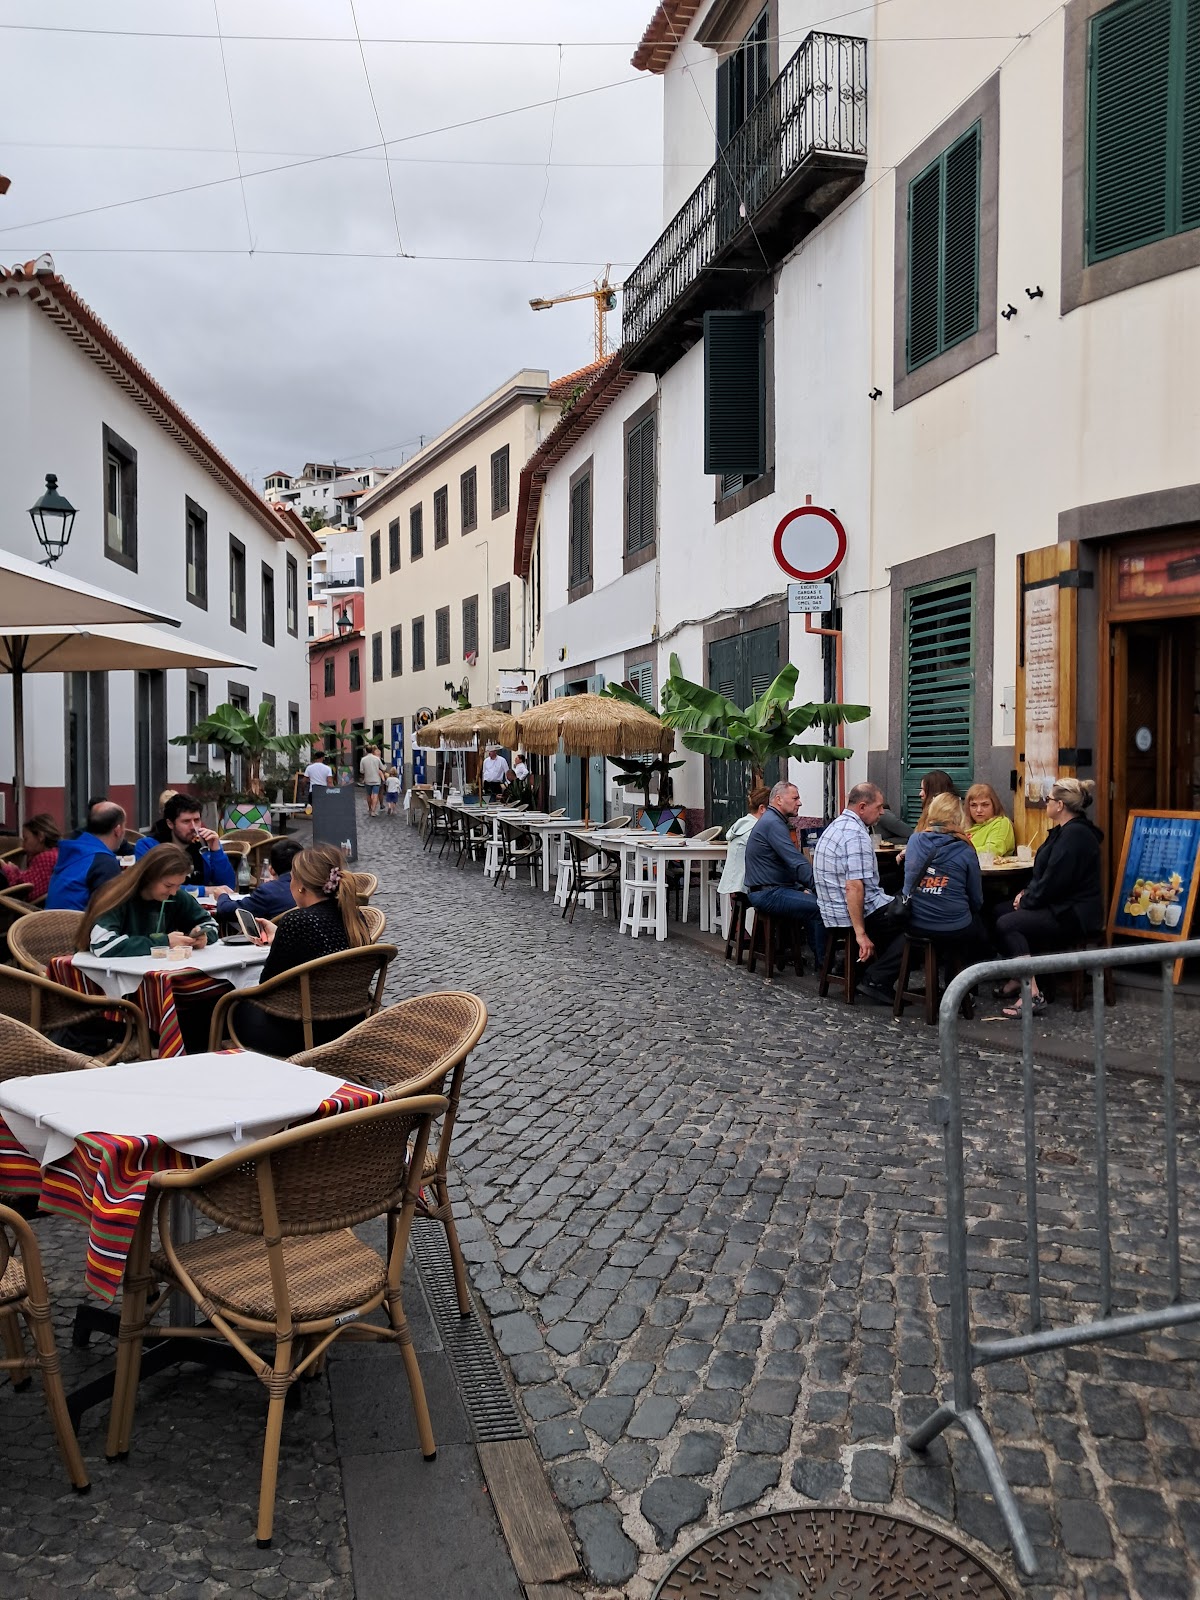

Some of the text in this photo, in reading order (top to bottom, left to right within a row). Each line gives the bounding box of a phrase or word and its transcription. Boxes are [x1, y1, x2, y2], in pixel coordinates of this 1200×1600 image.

[1142, 826, 1193, 837] BAR OFICIAL
[920, 875, 950, 888] FREE
